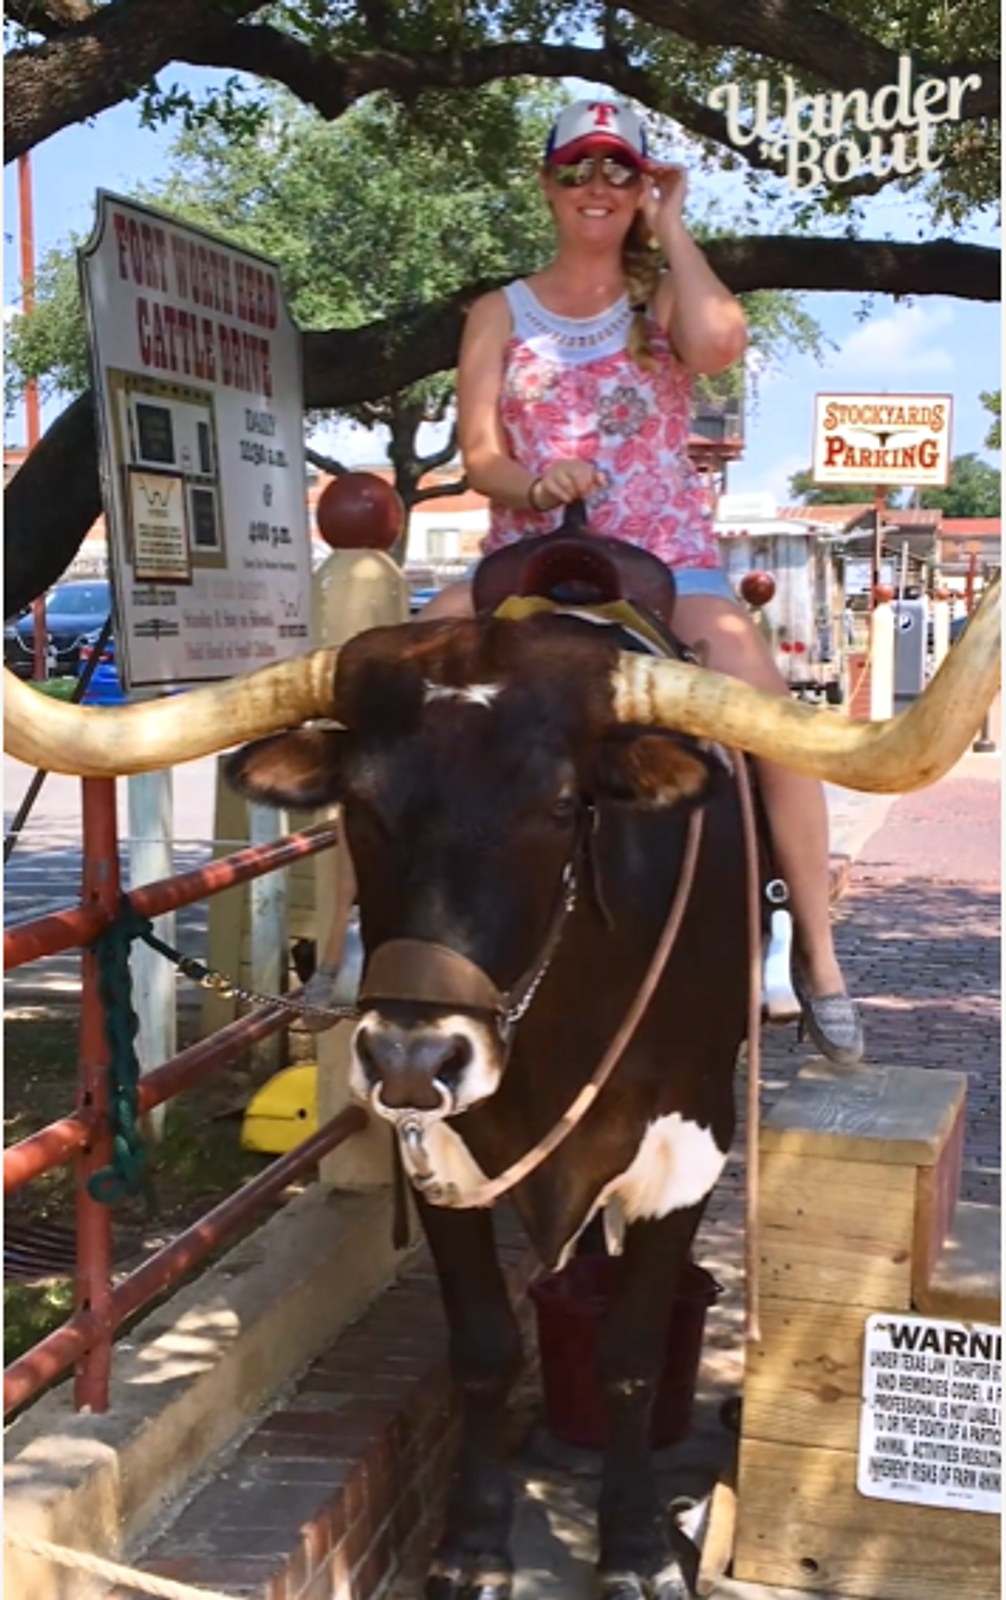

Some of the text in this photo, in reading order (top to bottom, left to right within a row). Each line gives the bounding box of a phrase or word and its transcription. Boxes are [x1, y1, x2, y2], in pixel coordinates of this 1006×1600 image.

[587, 102, 619, 127] T
[113, 212, 278, 331] FORT WORTH HERD
[136, 297, 273, 398] CATTLE DRIVE
[823, 401, 945, 433] STOCKYARDS
[823, 435, 940, 469] PARKING
